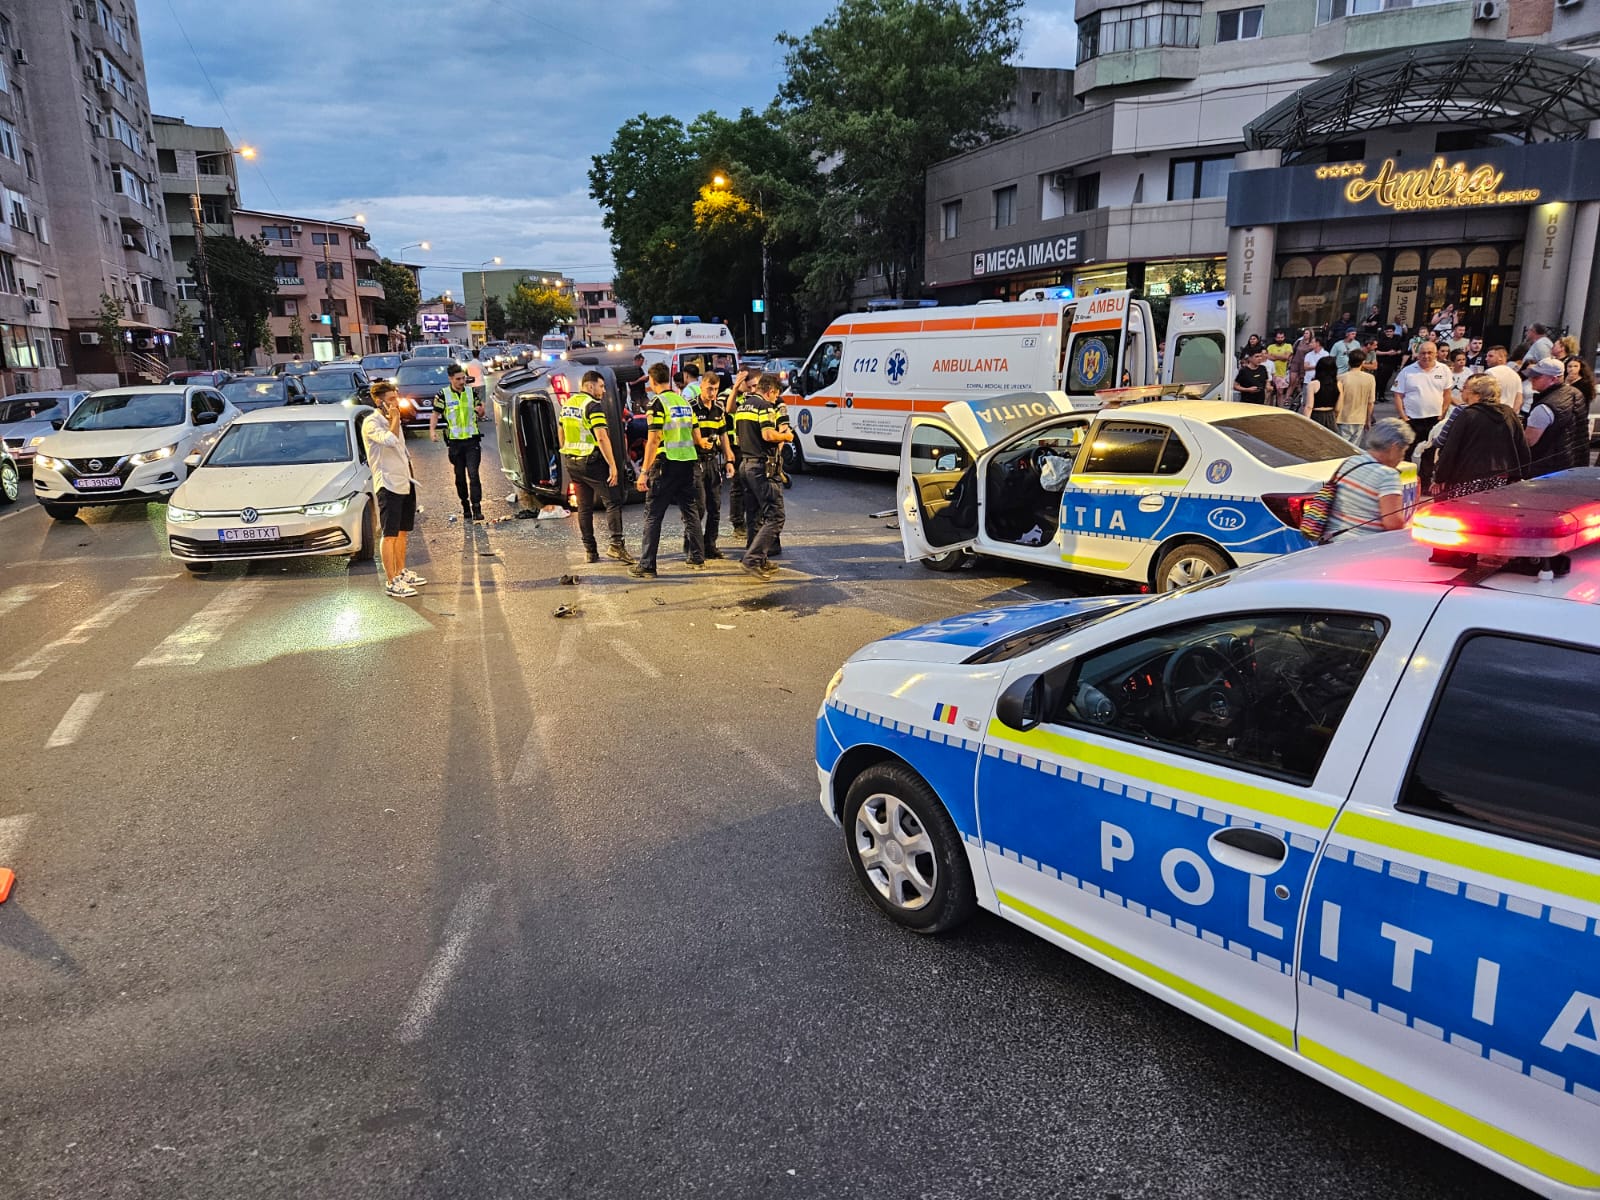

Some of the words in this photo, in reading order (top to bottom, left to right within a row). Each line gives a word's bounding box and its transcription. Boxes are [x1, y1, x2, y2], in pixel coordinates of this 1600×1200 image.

[1346, 157, 1504, 206] Ambra
[1394, 197, 1448, 210] BOUTIQUE
[1450, 194, 1484, 207] HOTEL
[1541, 214, 1559, 270] HOTEL
[986, 247, 1026, 272] MEGA
[1028, 236, 1077, 266] IMAGE
[1242, 236, 1255, 296] HOTEL
[1088, 297, 1125, 315] AMBU
[858, 358, 878, 373] 112
[932, 358, 1009, 372] AMBULANTA
[976, 402, 1060, 423] POLITIA
[1062, 505, 1126, 531] ITIA
[1218, 516, 1237, 528] 112
[225, 530, 239, 539] CT
[1100, 820, 1600, 1056] POLITIA
